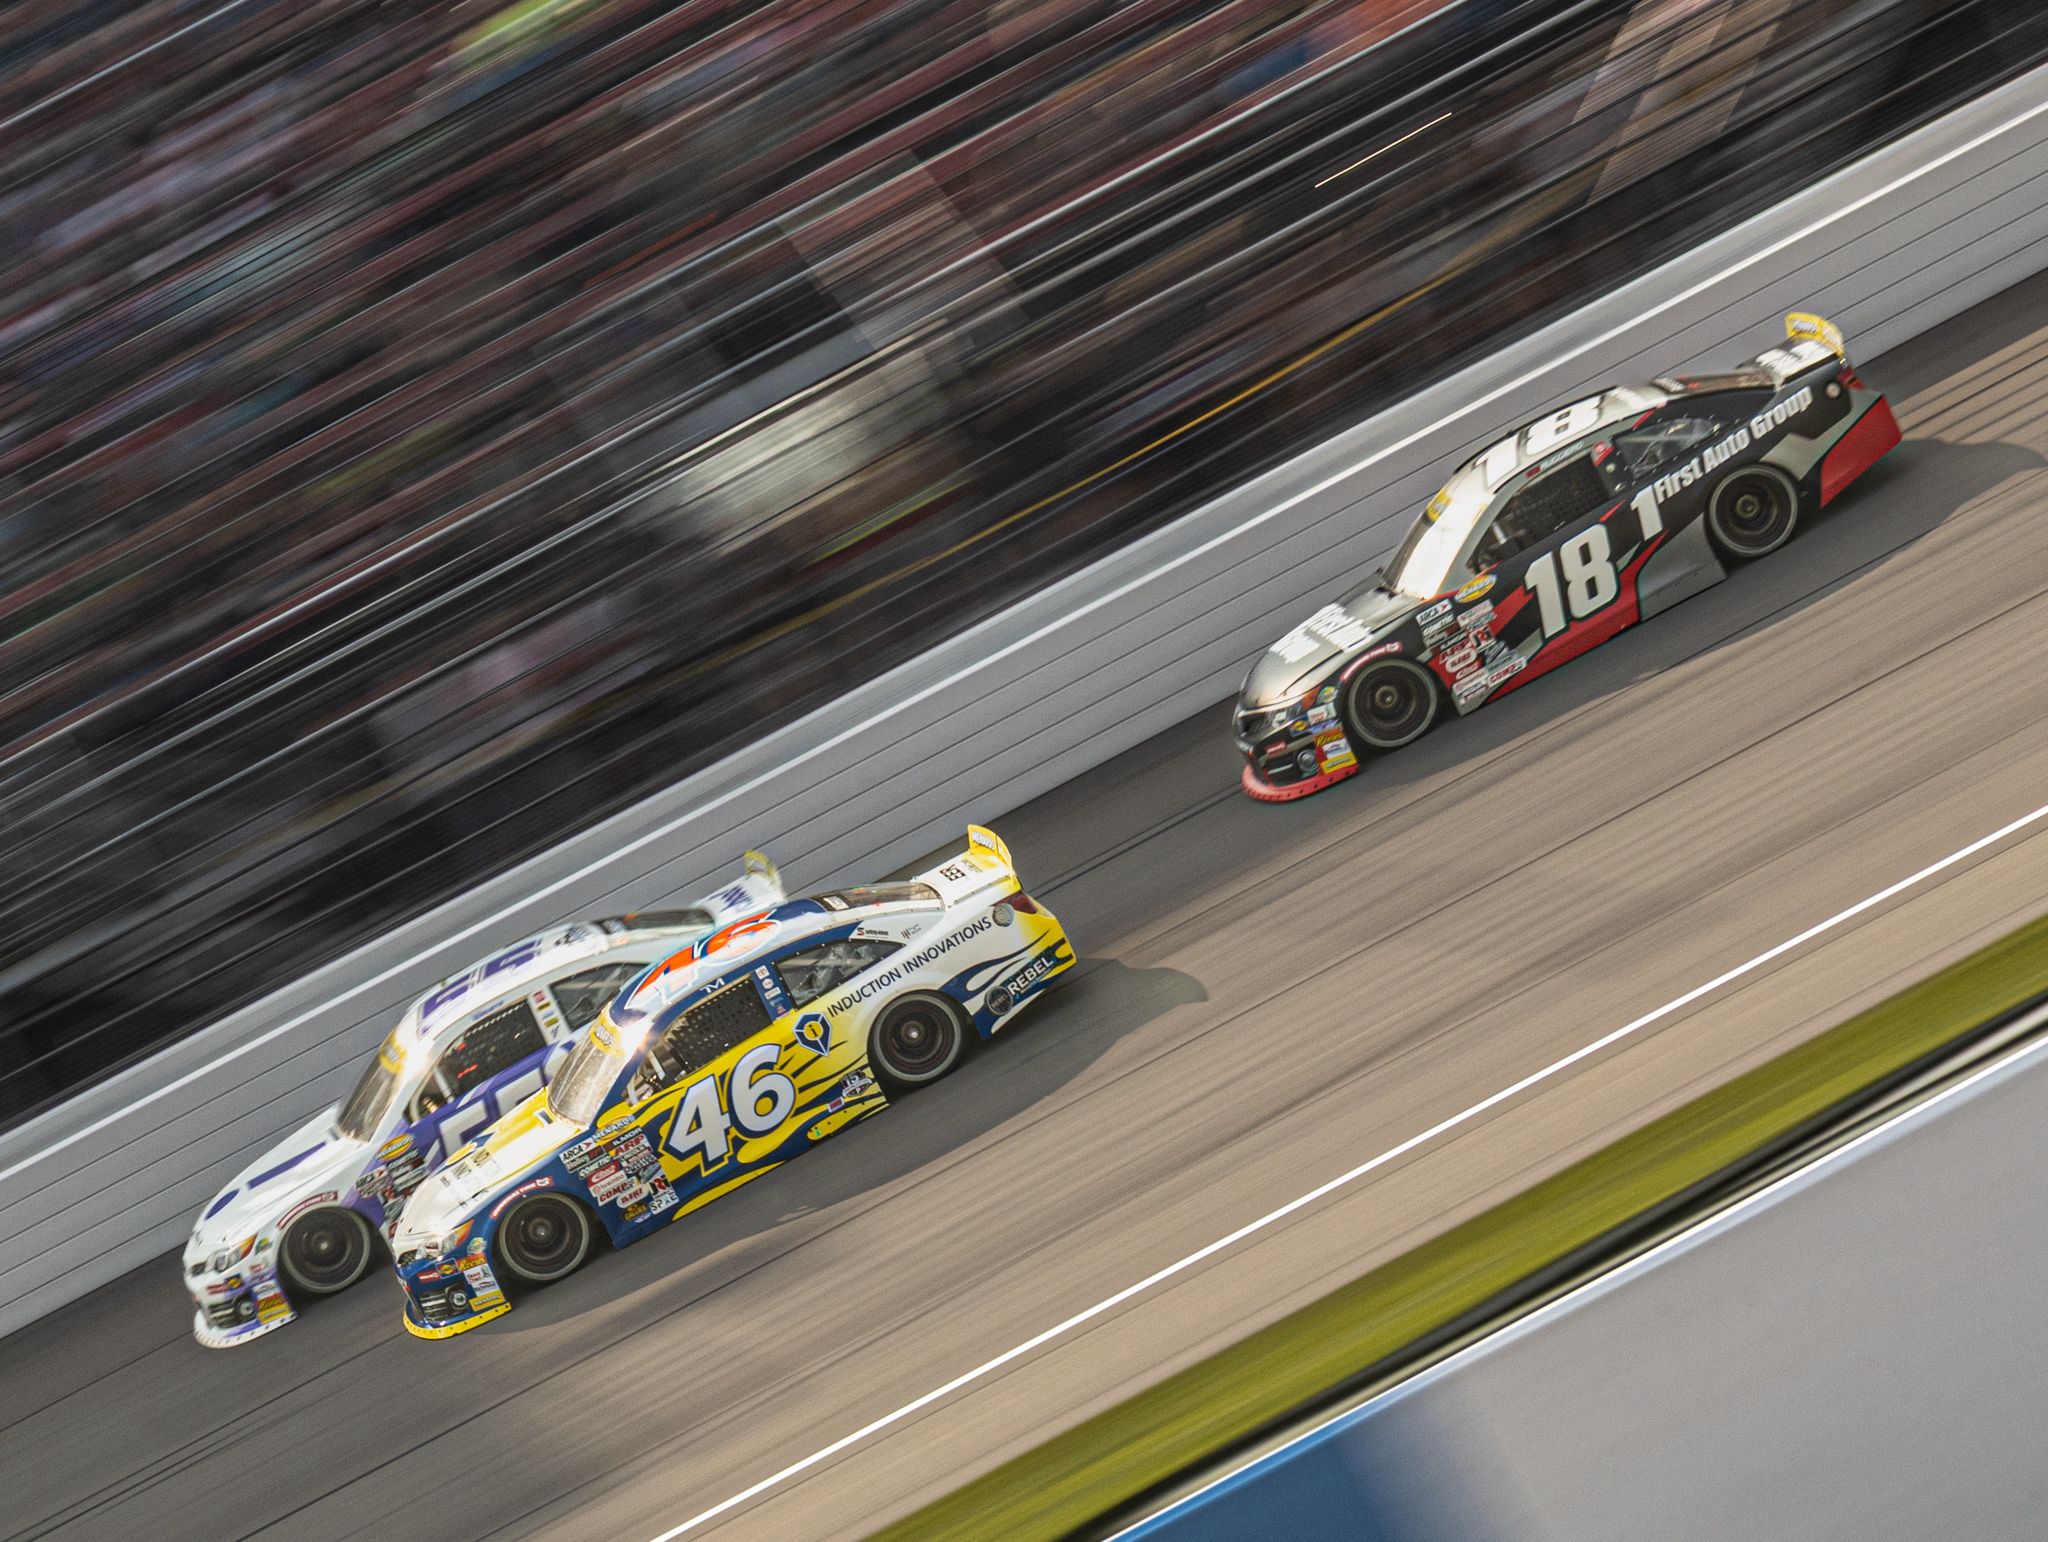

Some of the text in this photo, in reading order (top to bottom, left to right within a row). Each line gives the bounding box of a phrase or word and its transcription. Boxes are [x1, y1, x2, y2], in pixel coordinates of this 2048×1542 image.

[1474, 395, 1602, 489] 18
[1630, 386, 1814, 541] 1 First Auto Group
[1525, 523, 1618, 639] 18
[827, 916, 992, 1018] INDUCTION INNOVATIONS
[1008, 956, 1054, 996] REBEL
[591, 1114, 636, 1142] MENARDS
[668, 1043, 796, 1162] 46
[562, 1145, 584, 1161] ARCA
[612, 1127, 642, 1146] ILMOR
[614, 1133, 645, 1156] ARP
